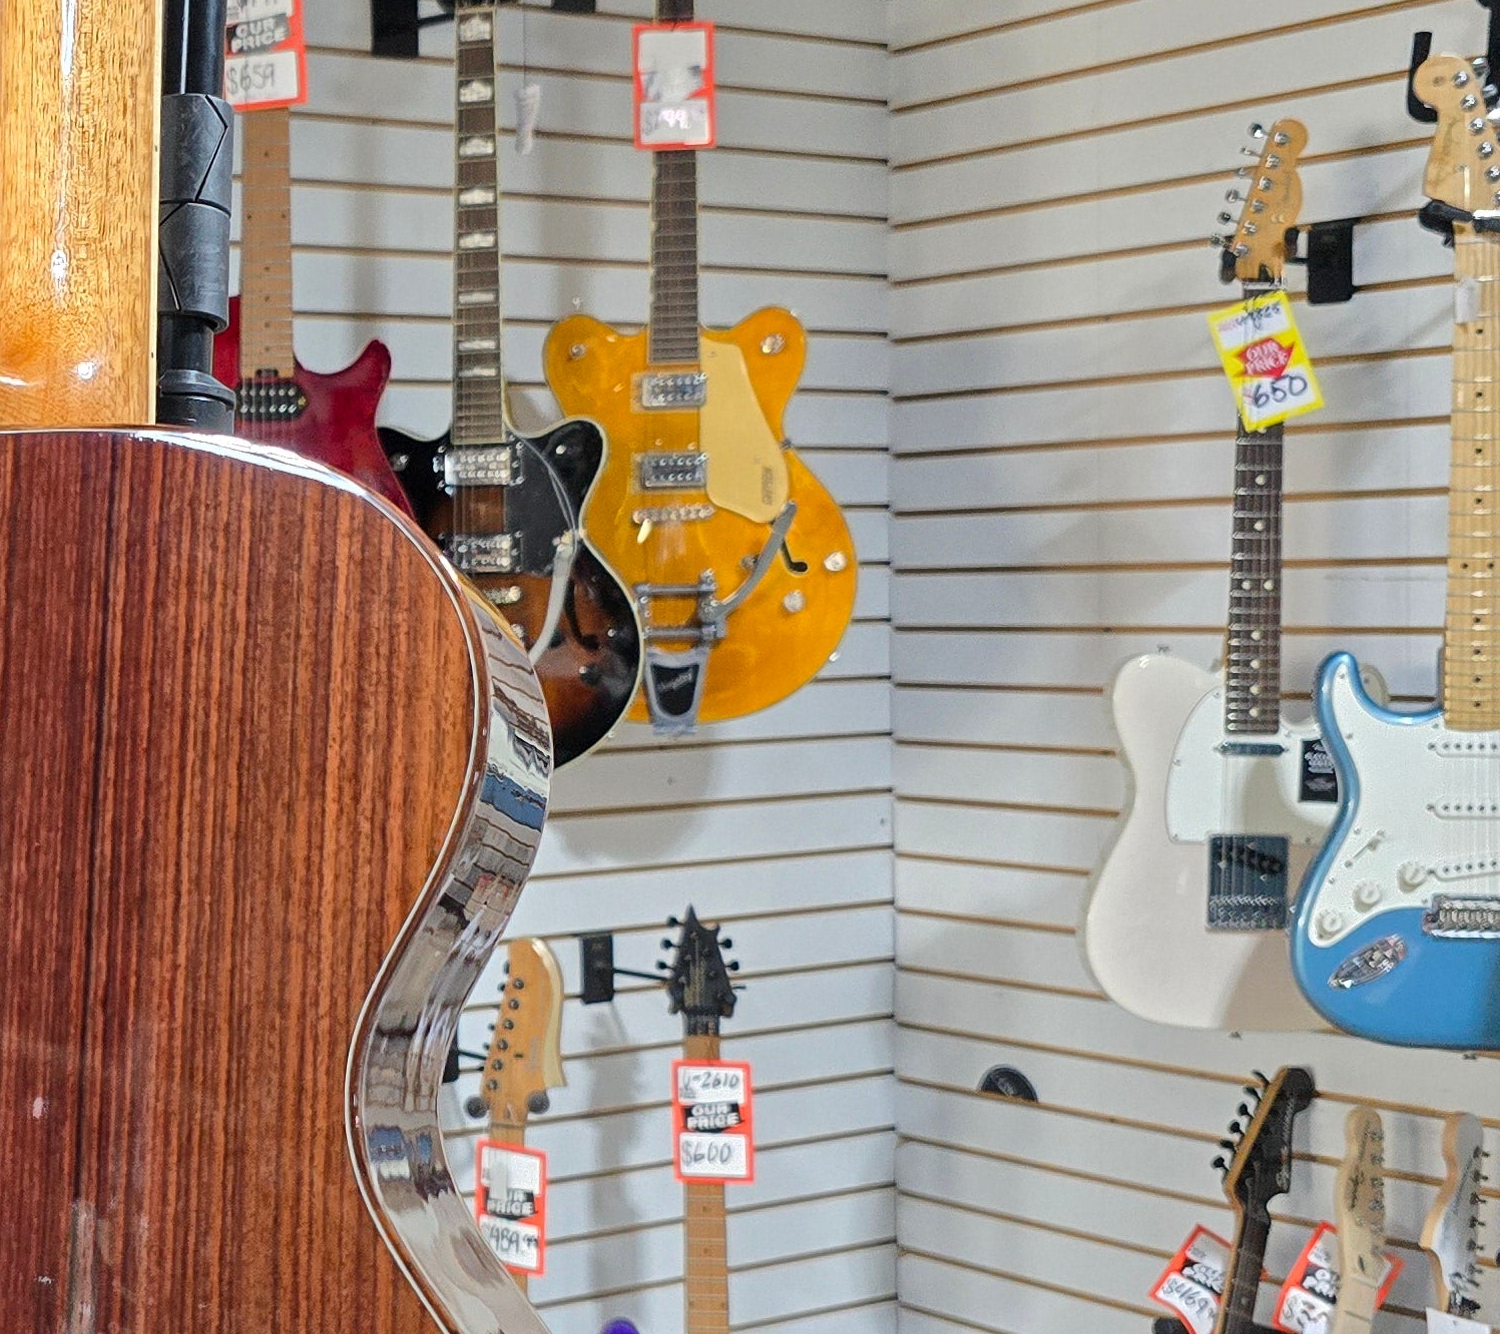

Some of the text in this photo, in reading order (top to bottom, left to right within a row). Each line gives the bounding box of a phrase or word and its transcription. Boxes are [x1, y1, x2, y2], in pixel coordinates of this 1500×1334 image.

[236, 17, 276, 37] OUR
[231, 27, 287, 54] PRICE
[1246, 339, 1280, 361] OUR
[691, 1103, 731, 1117] OUR
[687, 1112, 740, 1131] PRICE
[682, 1141, 732, 1167] $600
